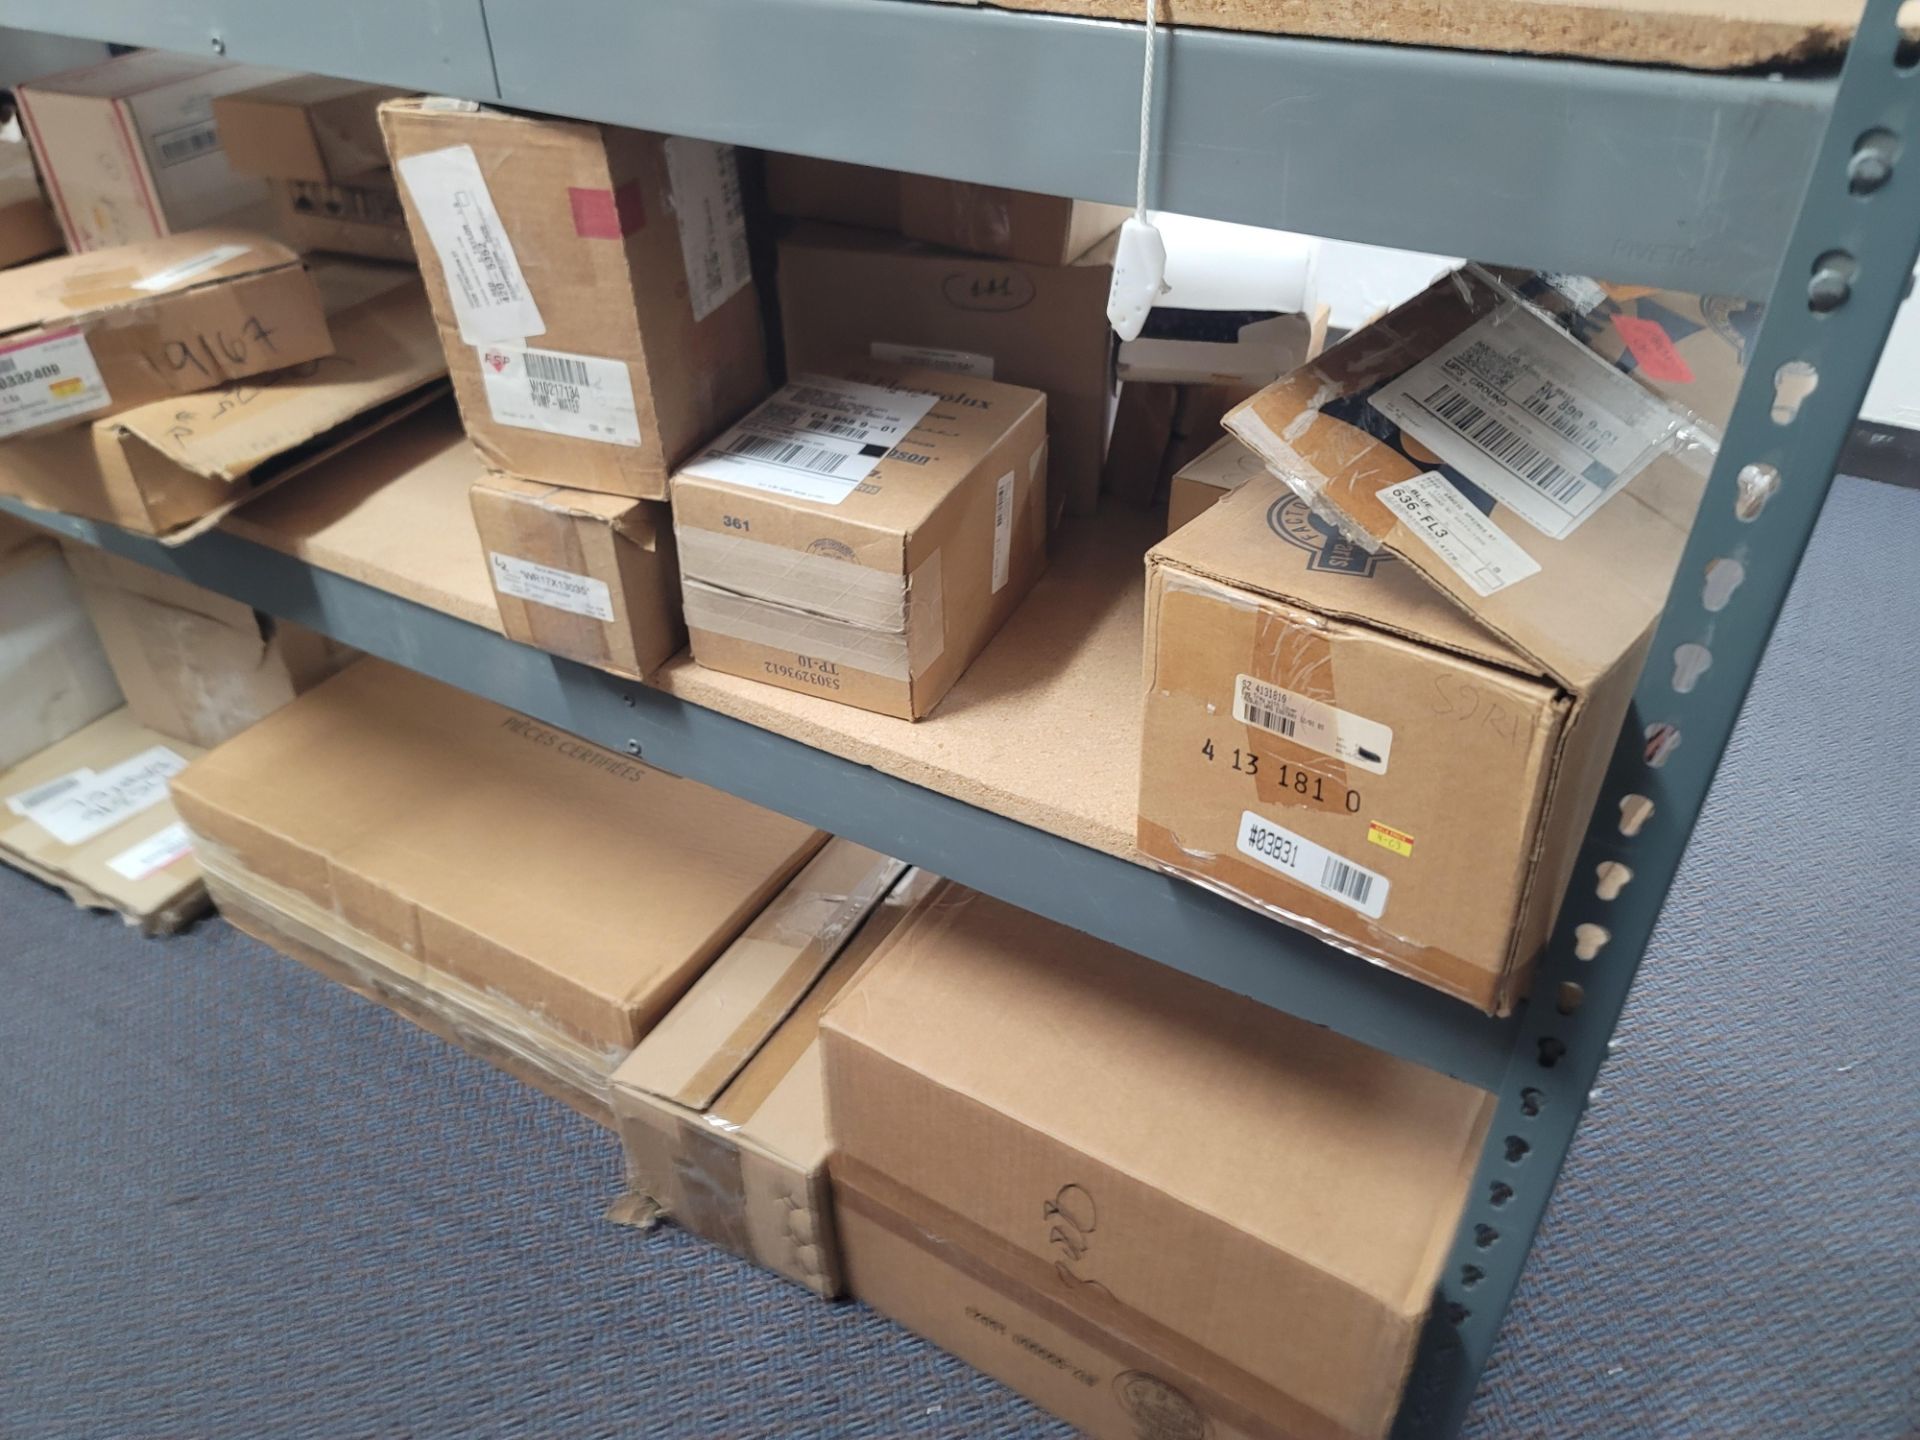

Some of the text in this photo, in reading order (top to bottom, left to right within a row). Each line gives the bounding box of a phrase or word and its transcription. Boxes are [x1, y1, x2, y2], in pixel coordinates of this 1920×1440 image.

[1444, 359, 1466, 378] UPS
[722, 515, 751, 532] 361
[1392, 488, 1449, 539] 636-FL3
[764, 661, 840, 691] 5303293612
[1202, 738, 1361, 813] 4 13 181 0
[1248, 823, 1299, 868] #03831
